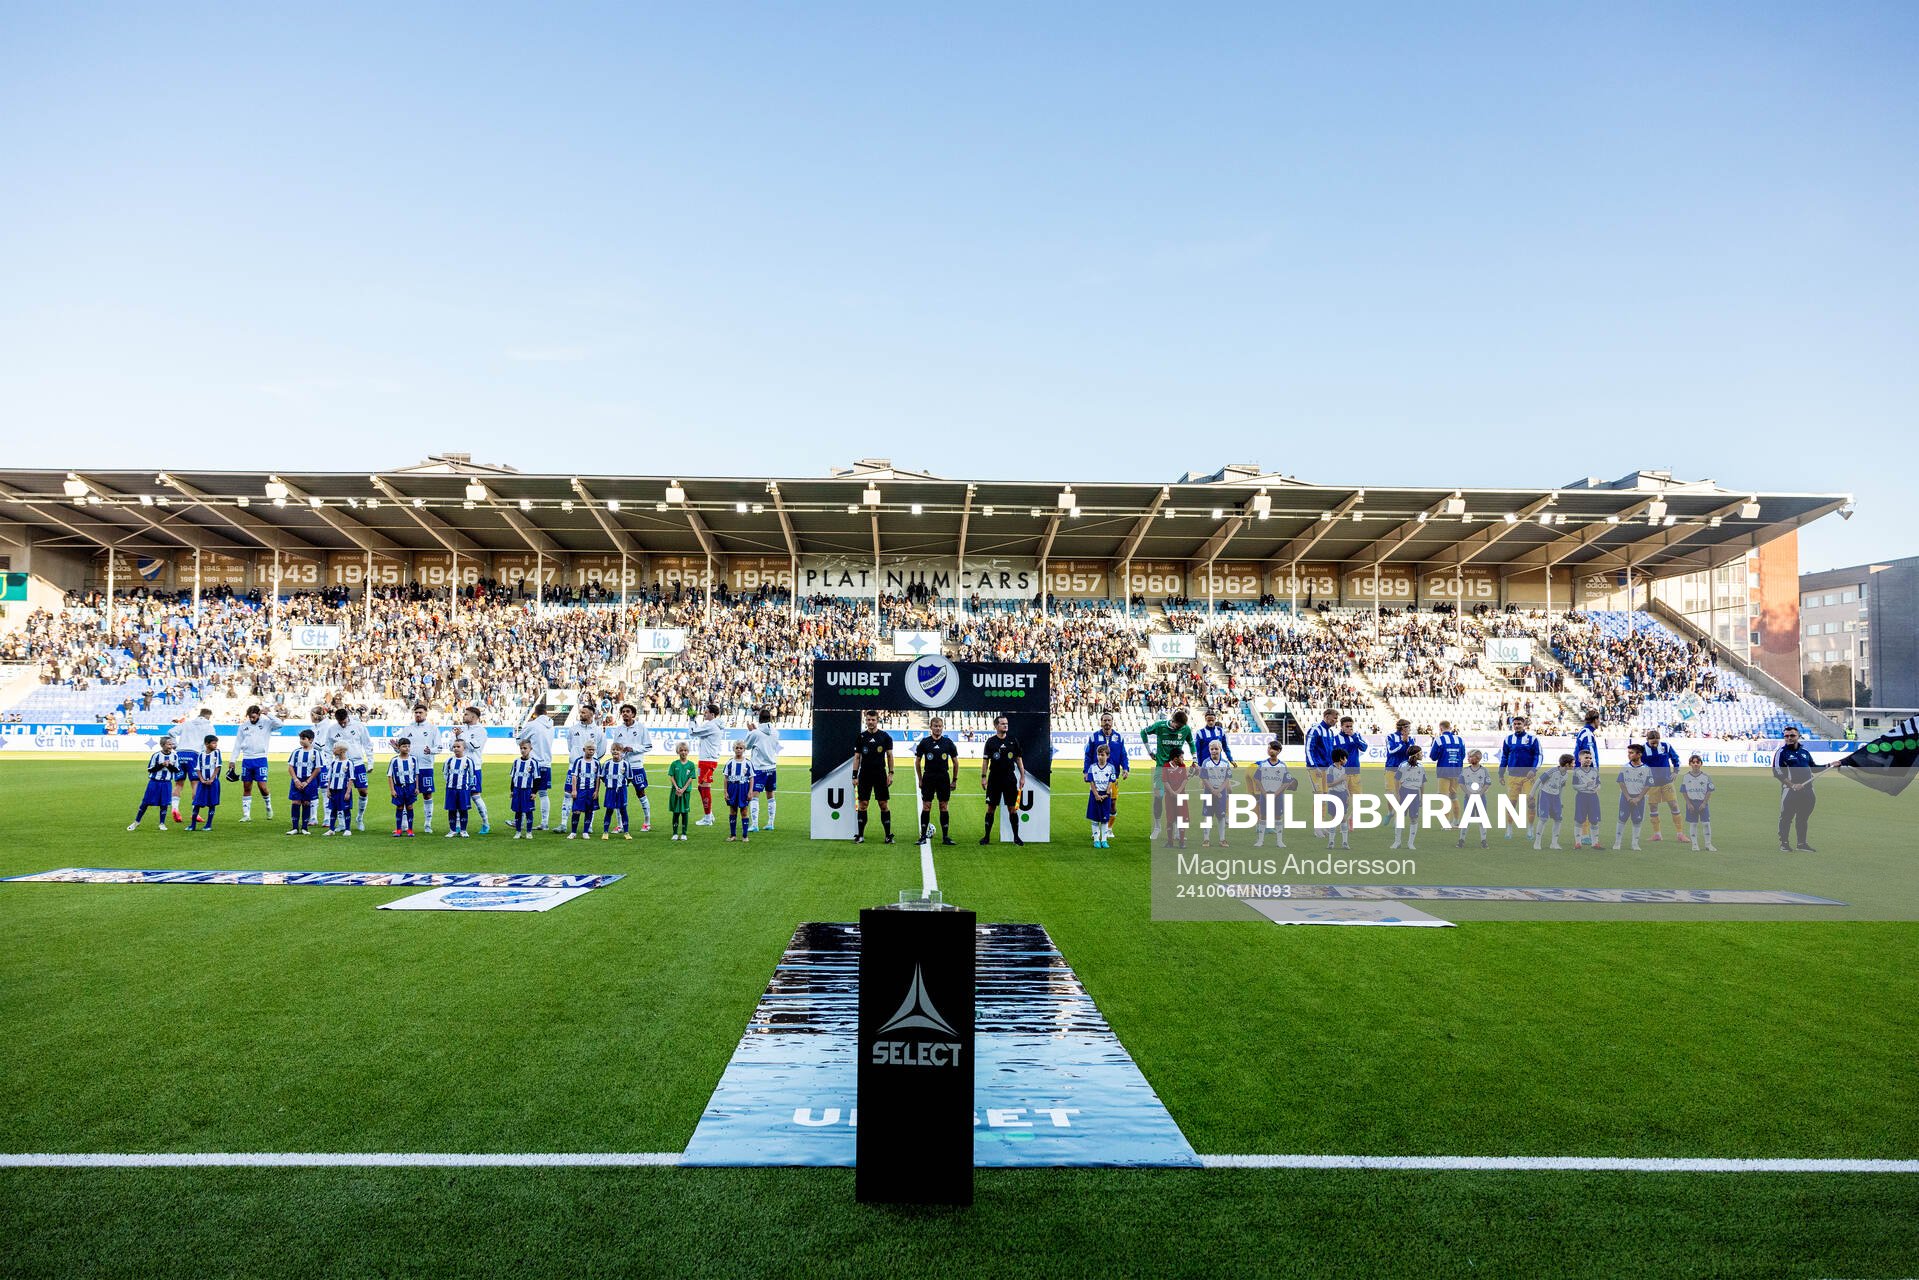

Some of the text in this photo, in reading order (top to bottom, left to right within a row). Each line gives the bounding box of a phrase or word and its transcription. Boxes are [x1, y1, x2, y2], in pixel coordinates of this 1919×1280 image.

[257, 564, 318, 583] 1943
[333, 564, 399, 584] 1945
[418, 566, 479, 585] 1946
[498, 567, 556, 586] 1947
[576, 567, 636, 587] 1948
[655, 568, 715, 588] 1952
[733, 569, 793, 588] 1956
[806, 569, 1030, 590] PLATNUMCARS
[1046, 573, 1102, 592] 1957
[1199, 575, 1257, 594] 1962
[1275, 576, 1334, 595] 1963
[1352, 577, 1410, 596] 1989
[1429, 578, 1493, 597] 2015
[1161, 638, 1181, 654] ett
[826, 671, 892, 687] UNIBET
[972, 673, 1038, 688] UNIBET
[1, 725, 75, 735] HOLMEN
[1715, 751, 1730, 763] liv
[1753, 752, 1772, 766] lag
[828, 788, 844, 810] U
[1018, 790, 1034, 811] U
[872, 1041, 962, 1067] SELECT
